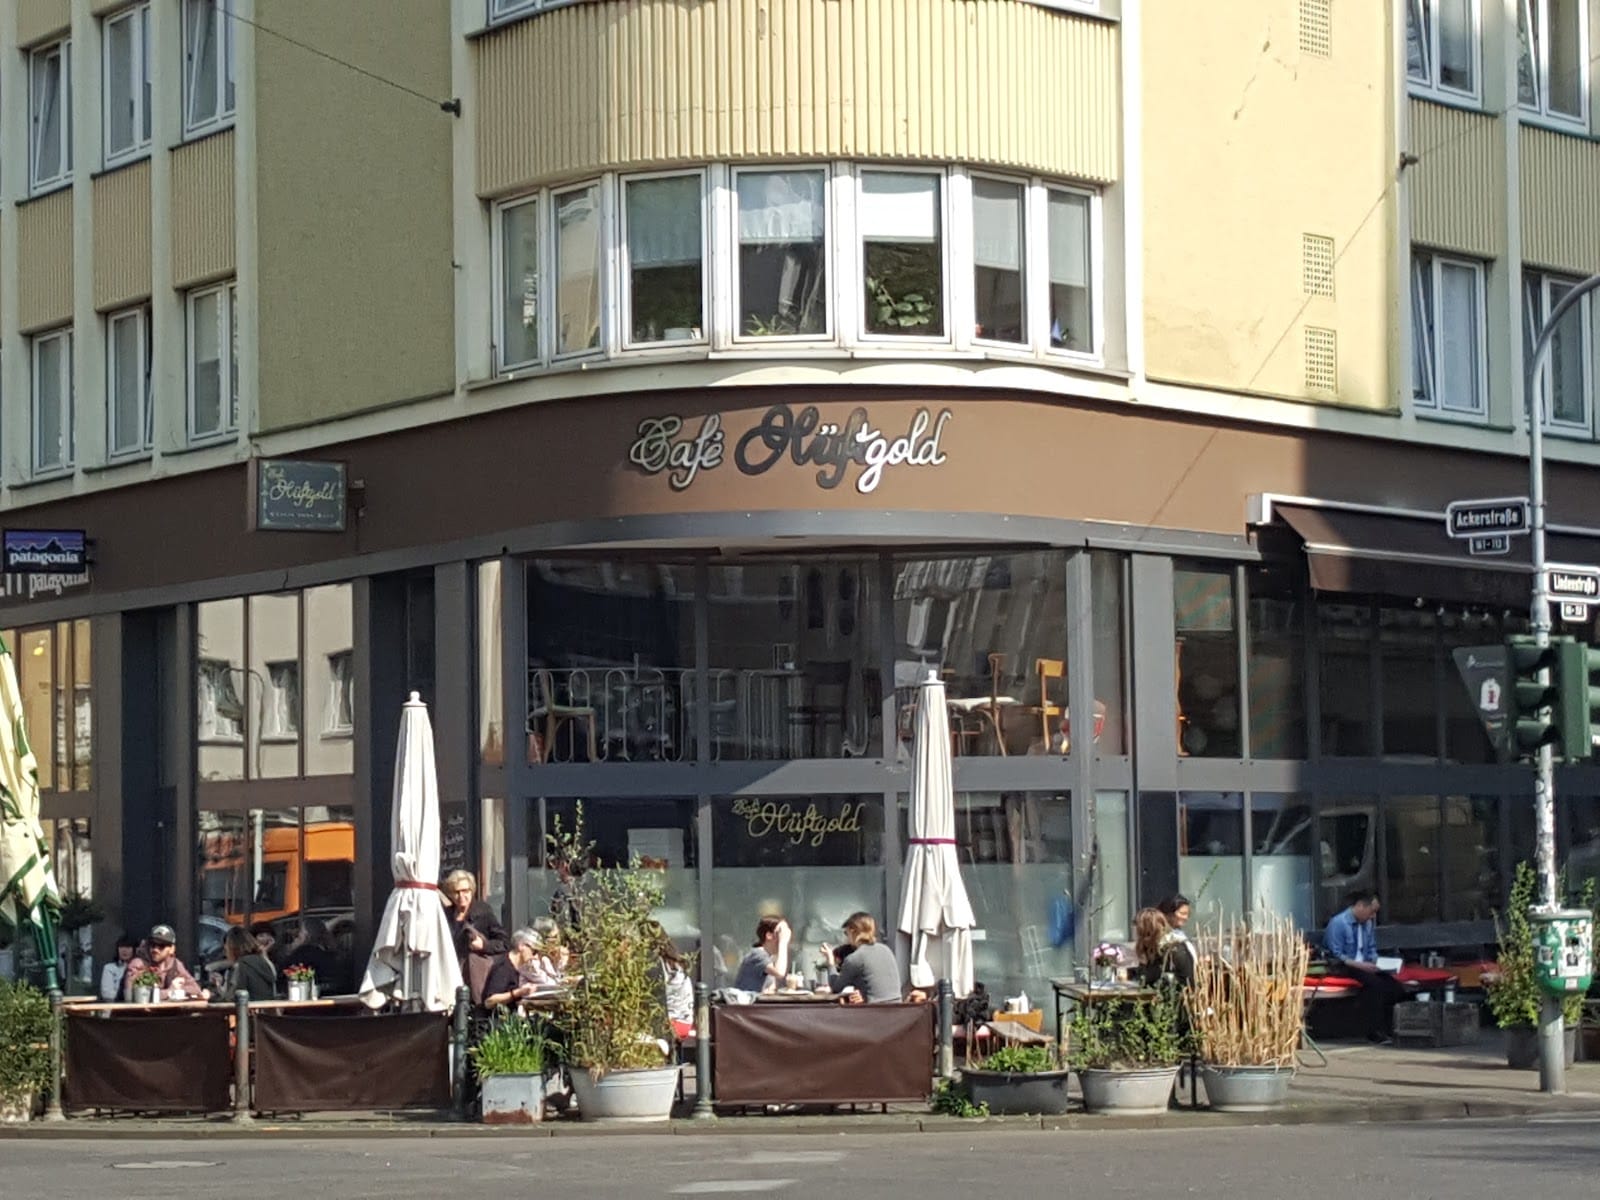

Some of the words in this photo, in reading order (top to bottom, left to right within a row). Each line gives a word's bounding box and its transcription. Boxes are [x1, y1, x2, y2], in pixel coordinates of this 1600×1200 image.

[630, 411, 725, 491] Café
[734, 403, 953, 493] Hüftgold
[1456, 508, 1519, 527] Ackerstraße
[9, 551, 80, 566] patagonia
[748, 802, 866, 847] Hüftgold
